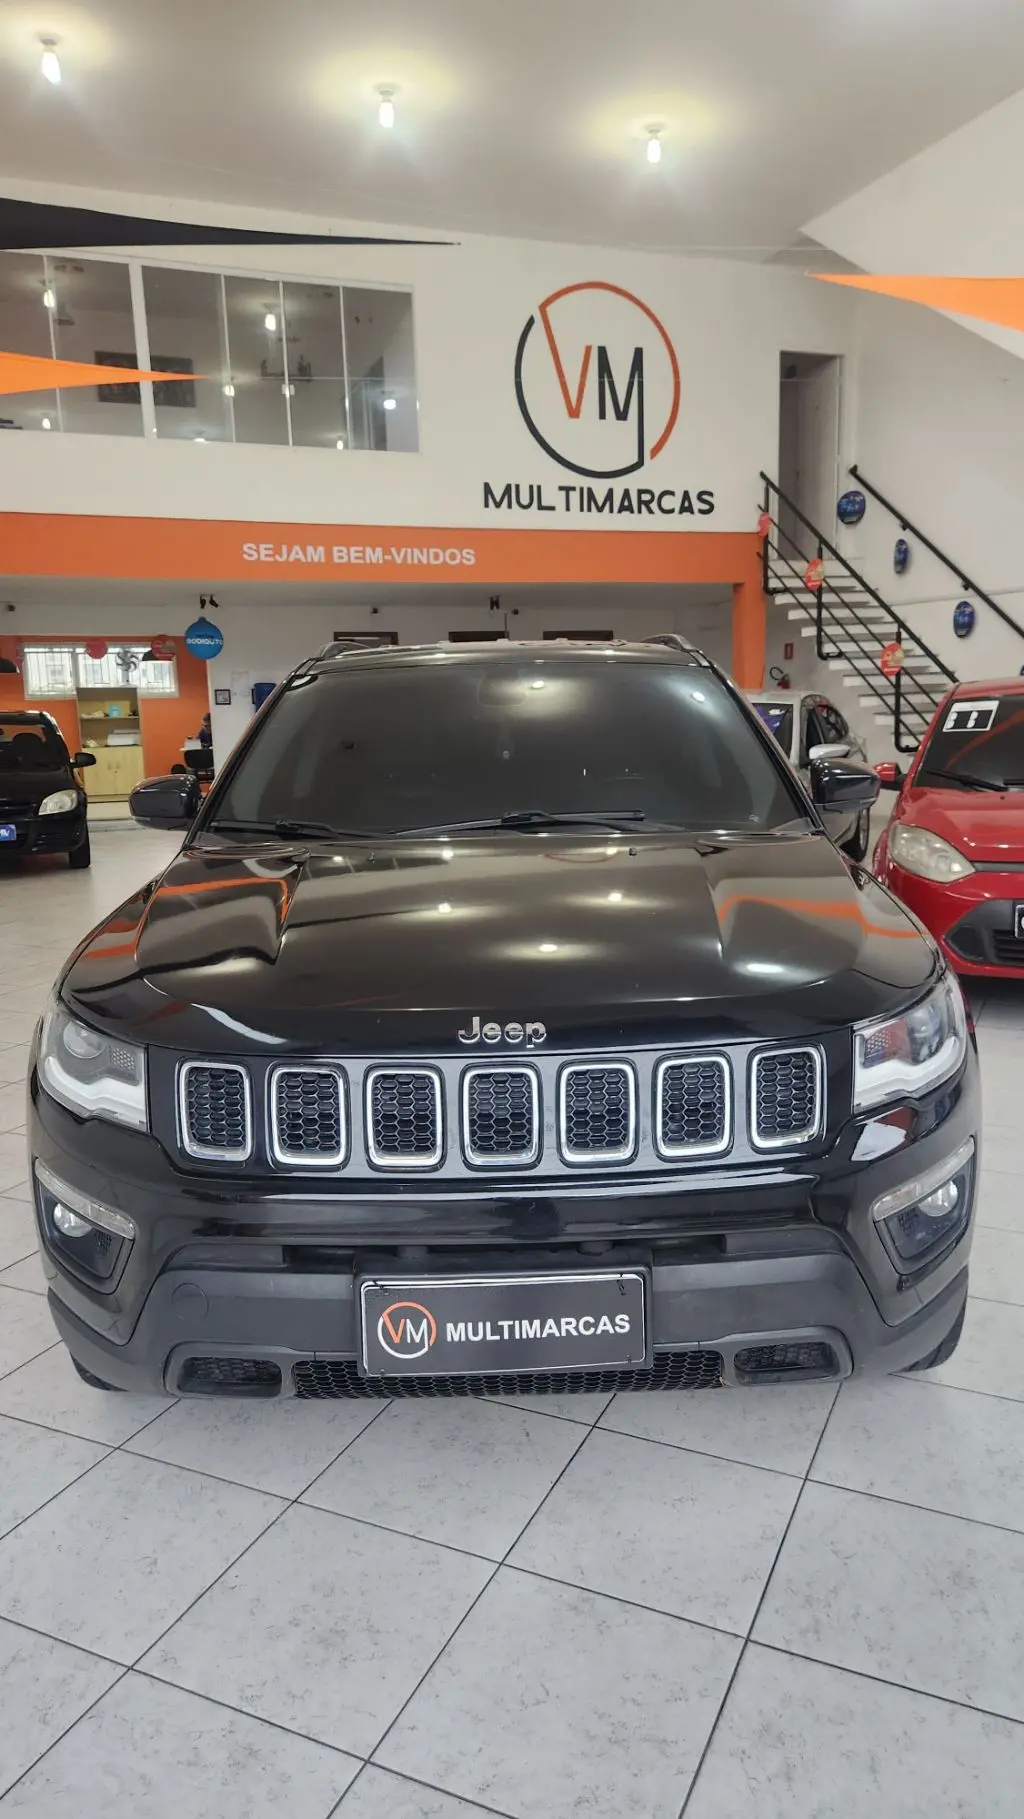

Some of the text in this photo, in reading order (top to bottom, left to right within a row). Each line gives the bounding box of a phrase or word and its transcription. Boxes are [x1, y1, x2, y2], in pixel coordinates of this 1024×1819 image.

[483, 481, 715, 515] MULTIMARCAS
[242, 542, 476, 565] SEJAM BEM-VINDOS
[457, 1016, 547, 1048] Jeep
[446, 1314, 631, 1342] MULTIMARCAS
